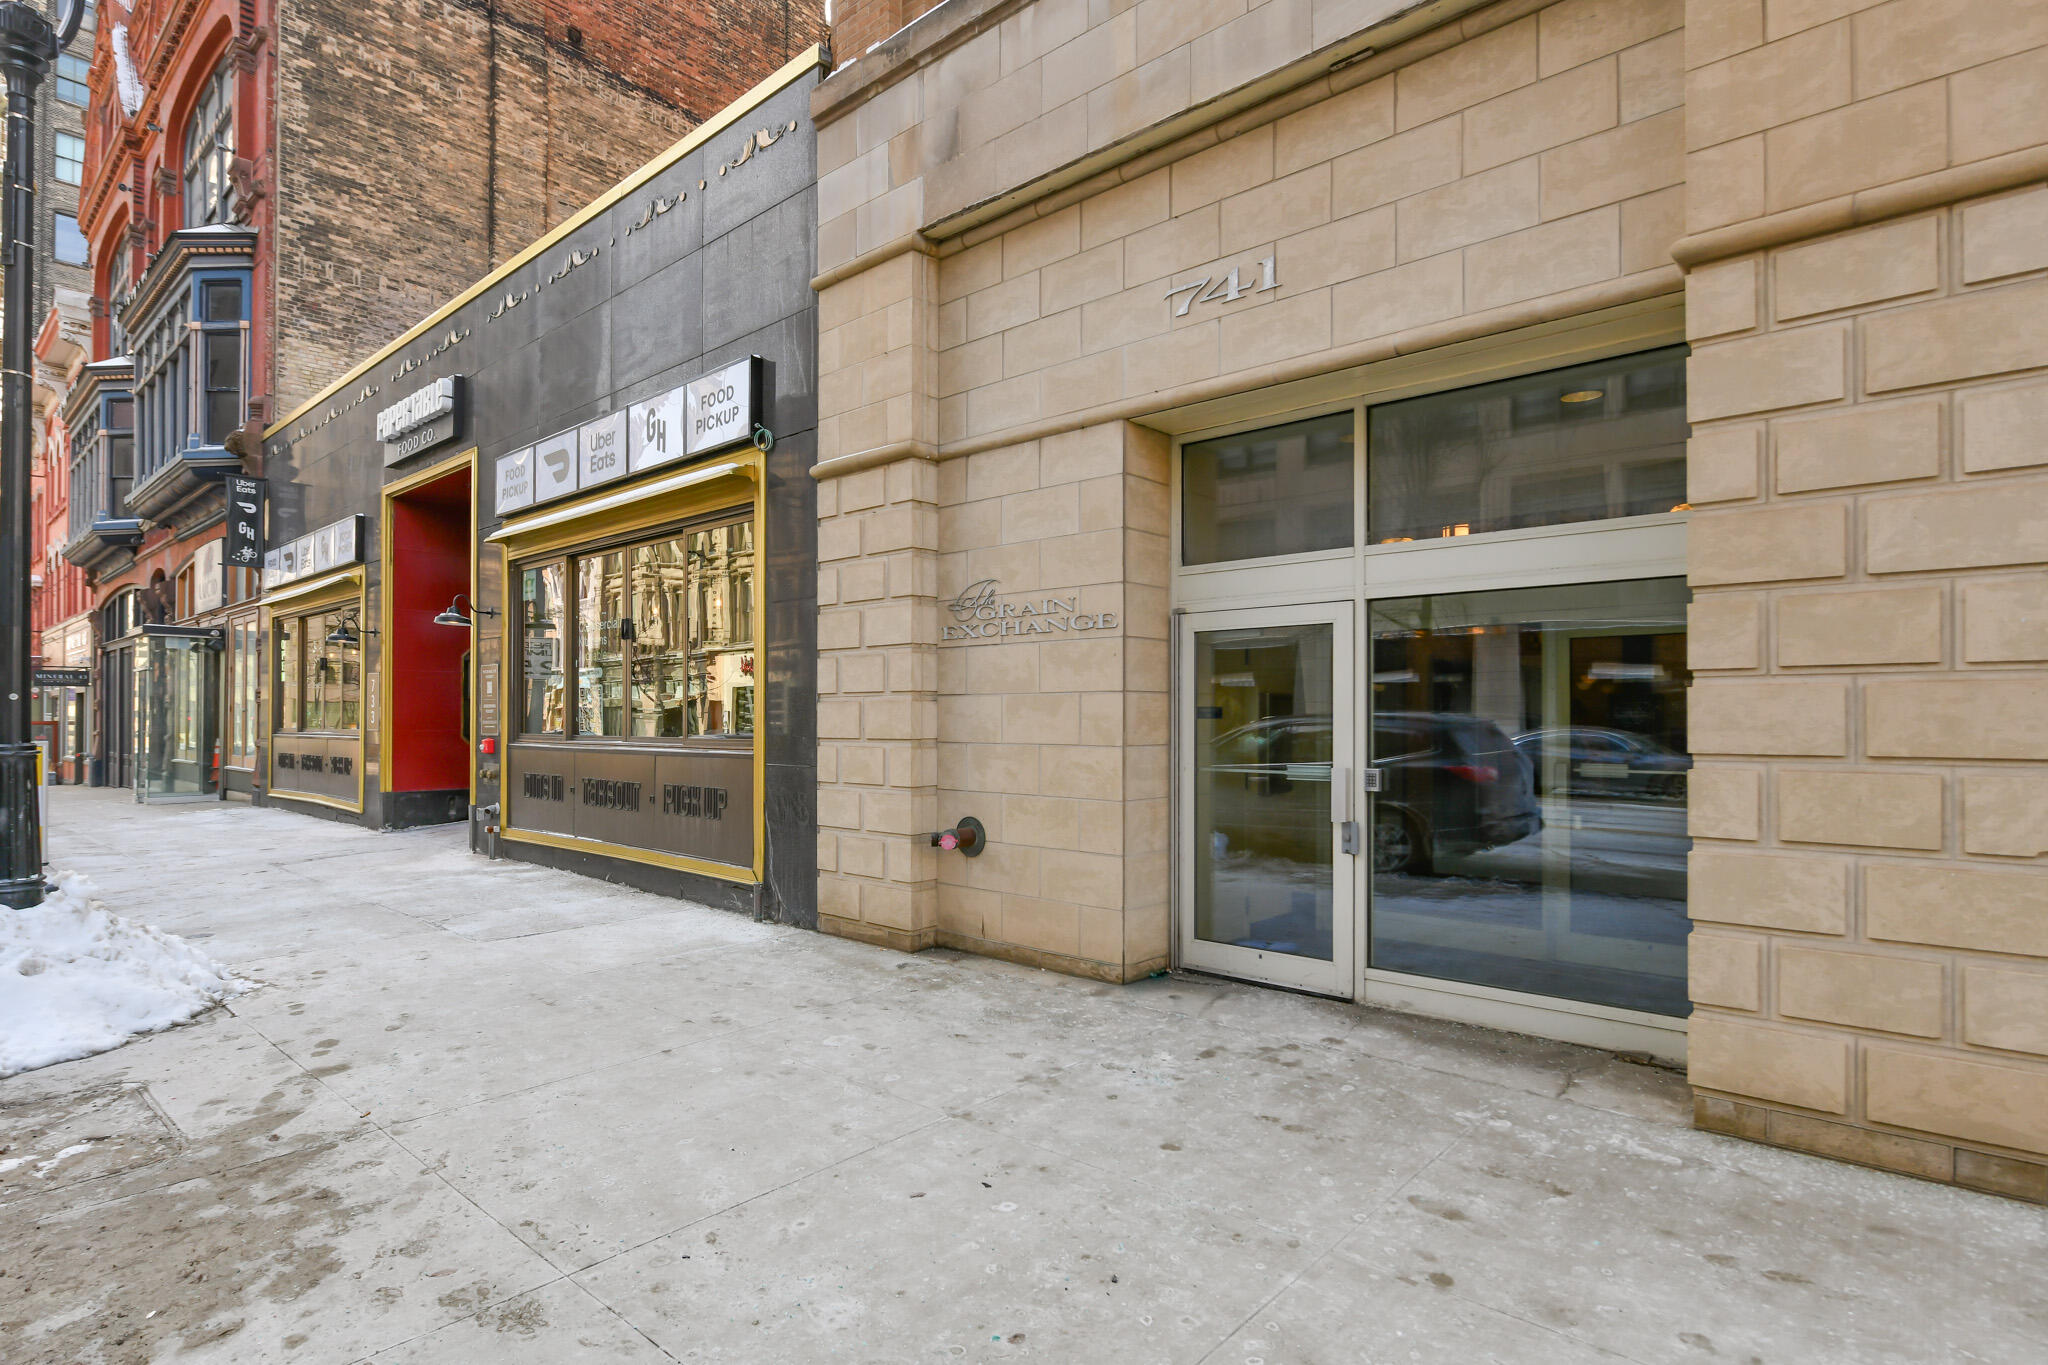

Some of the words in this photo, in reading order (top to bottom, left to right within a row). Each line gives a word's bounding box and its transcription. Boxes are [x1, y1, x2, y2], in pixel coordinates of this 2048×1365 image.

[1161, 254, 1283, 318] 741
[700, 385, 735, 411] FOOD
[646, 407, 666, 453] GH
[695, 405, 740, 435] PICKUP
[397, 436, 419, 456] FOOD
[421, 428, 437, 444] CO.
[590, 430, 616, 451] Uber
[505, 464, 526, 481] FOOD
[590, 451, 616, 474] Eats
[236, 479, 256, 488] Uber
[236, 486, 256, 494] Eats
[502, 481, 528, 500] PICKUP
[238, 521, 254, 540] GH
[948, 579, 1000, 622] The
[975, 596, 1076, 620] GRAIN
[941, 612, 1119, 641] EXCHANGE
[704, 787, 728, 820] UP
